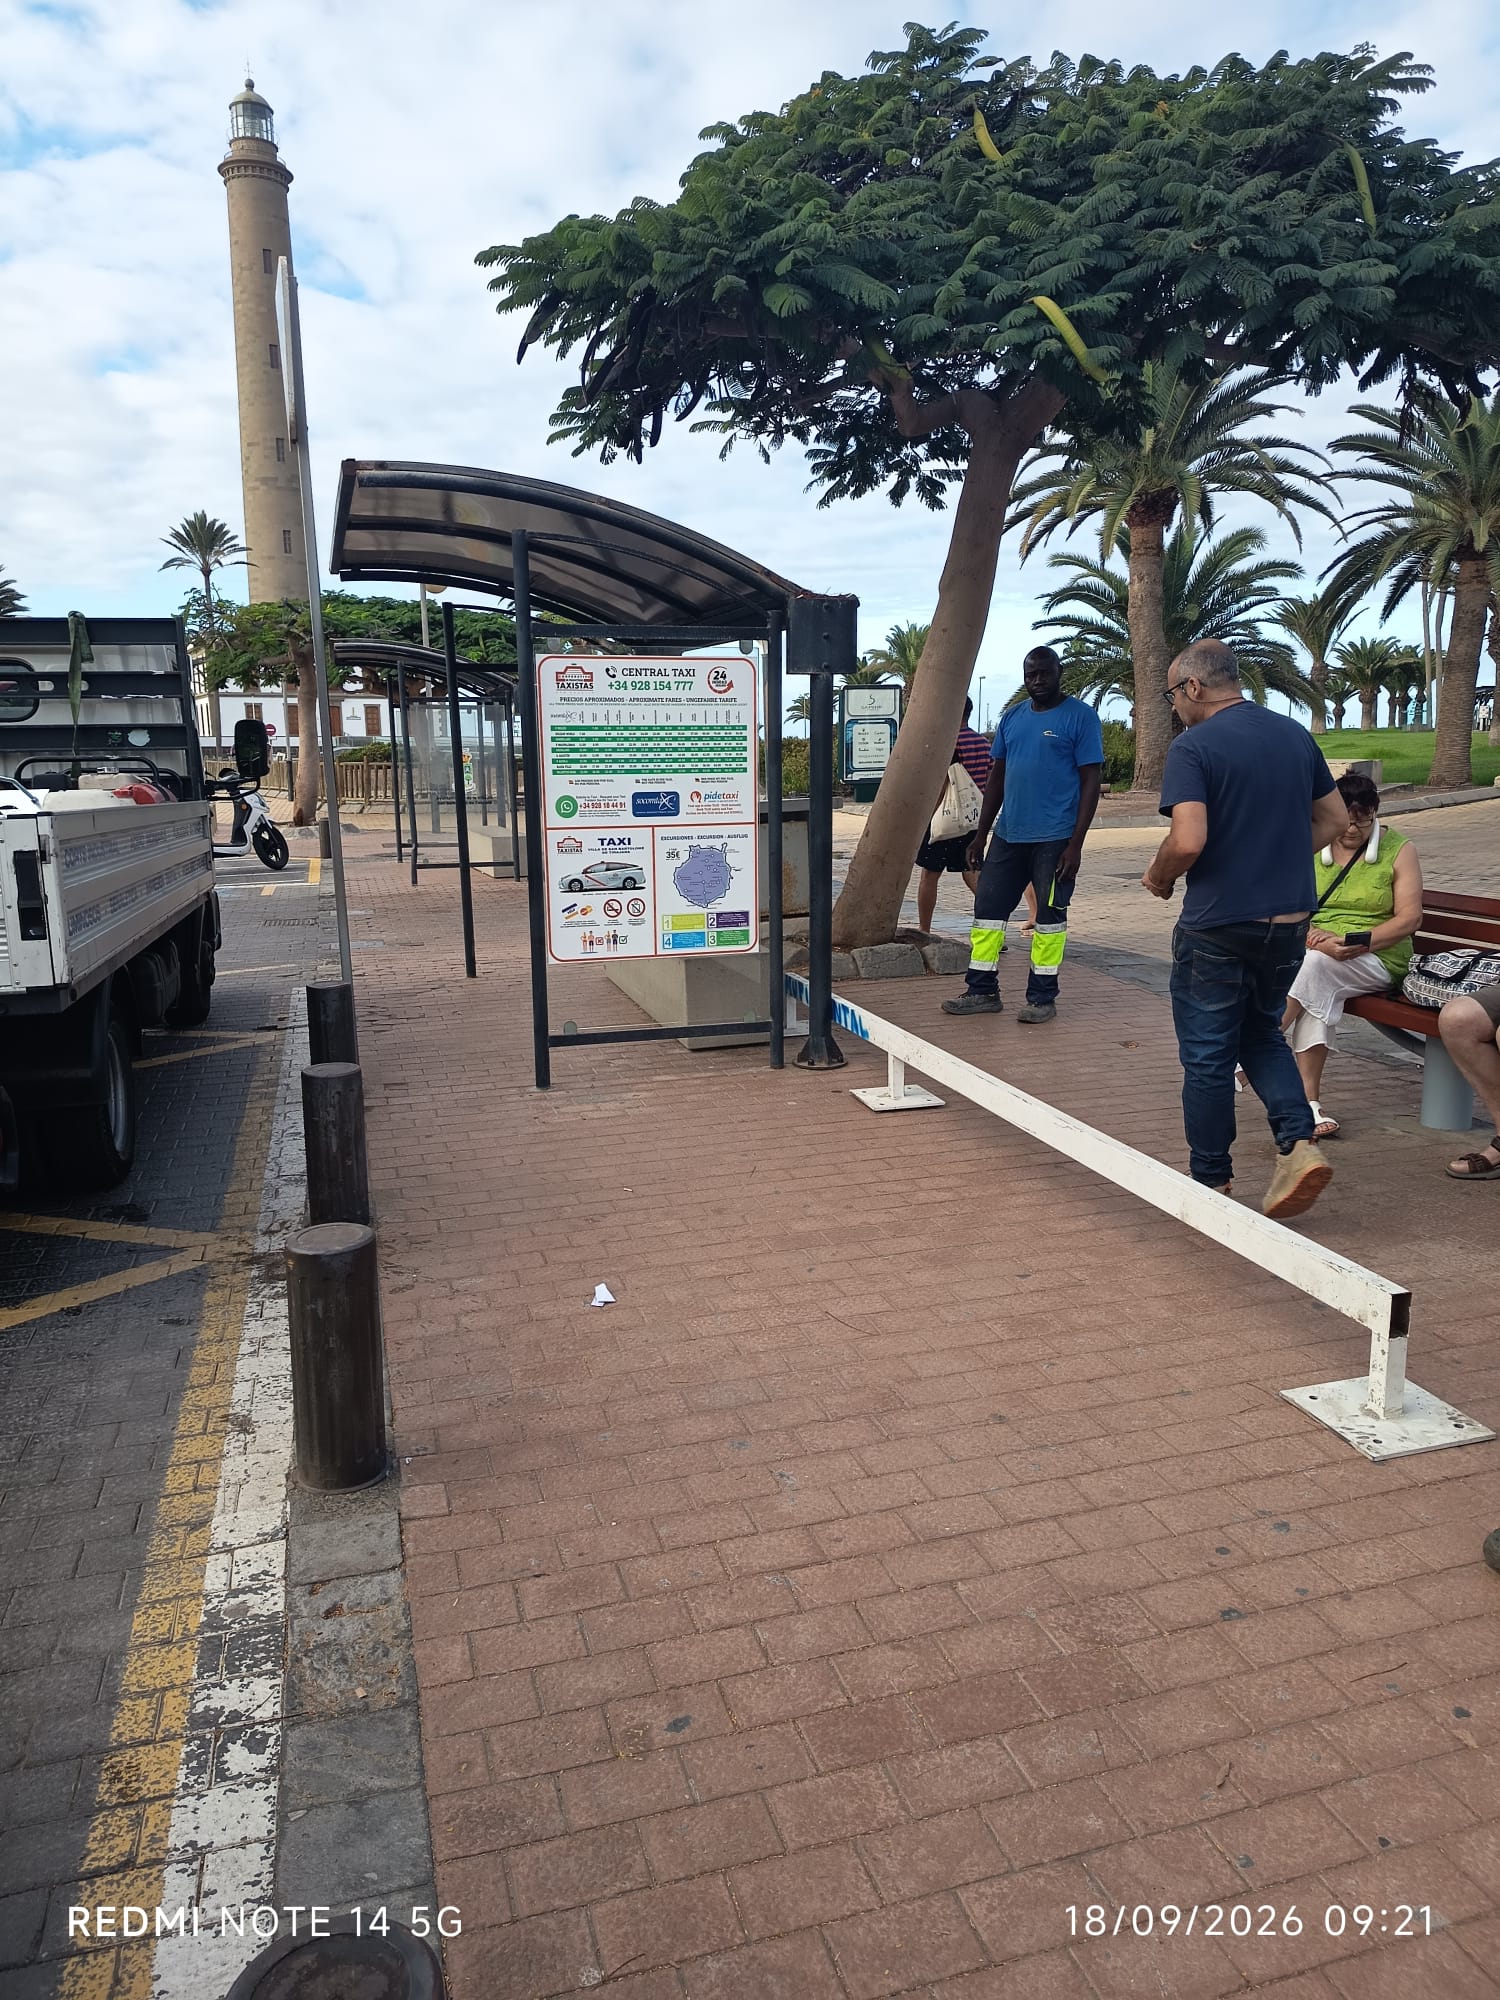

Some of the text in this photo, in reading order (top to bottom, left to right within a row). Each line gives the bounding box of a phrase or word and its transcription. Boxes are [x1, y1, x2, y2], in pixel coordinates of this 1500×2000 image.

[621, 668, 696, 677] CENTRAL TAXI
[713, 670, 727, 681] 24
[556, 682, 594, 690] TAXISTAS
[608, 680, 694, 691] +34 928 154 777
[703, 790, 740, 802] pidetaxi
[597, 837, 632, 847] TAXI
[665, 850, 681, 859] 35€
[709, 916, 716, 927] 2
[664, 937, 672, 947] 4
[709, 935, 716, 945] 3
